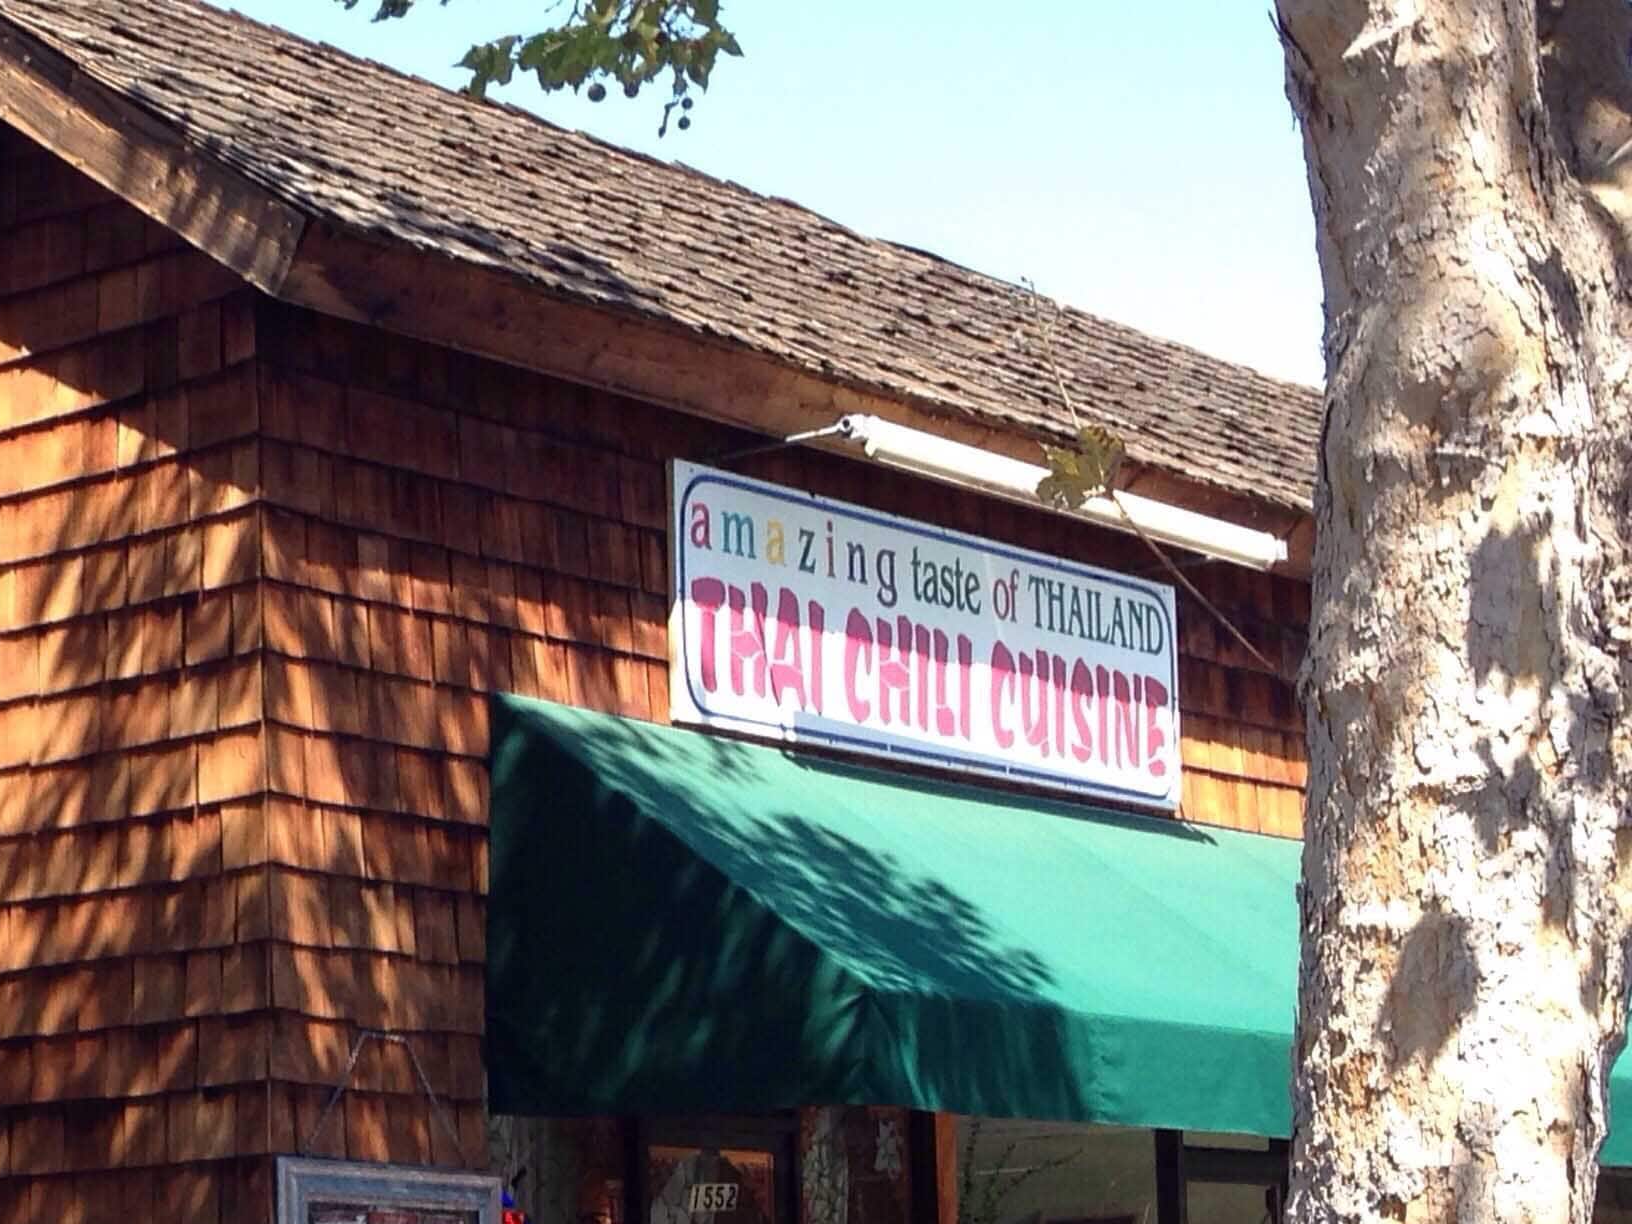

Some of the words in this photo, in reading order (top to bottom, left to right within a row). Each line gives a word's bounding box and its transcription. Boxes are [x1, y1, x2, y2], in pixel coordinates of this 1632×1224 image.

[690, 501, 898, 608] amazing
[912, 547, 982, 615] taste
[993, 569, 1020, 622] of
[1027, 576, 1164, 656] THAILAND
[690, 576, 825, 715] THAI
[844, 607, 972, 741] CHILI
[990, 640, 1169, 778] CUISINE
[694, 1186, 737, 1209] 1552
